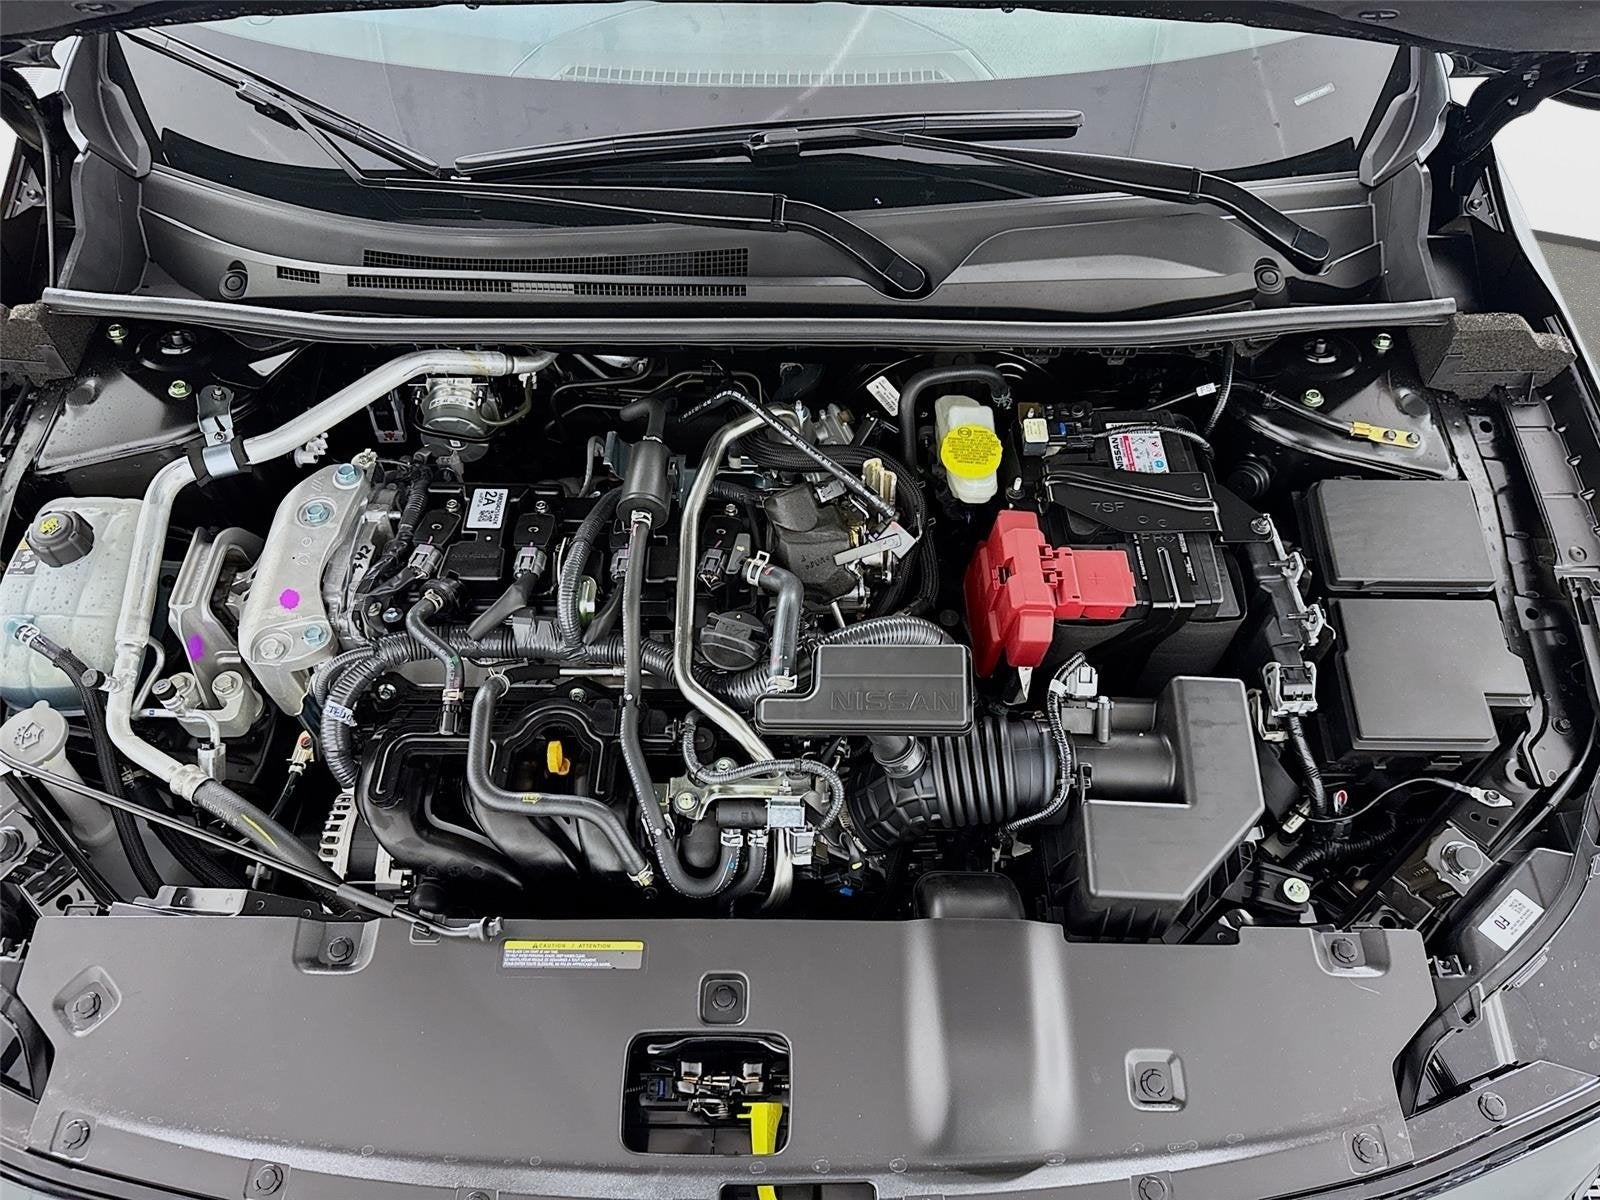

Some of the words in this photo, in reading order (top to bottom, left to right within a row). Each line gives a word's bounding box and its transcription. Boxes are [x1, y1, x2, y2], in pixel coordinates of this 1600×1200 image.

[1111, 437, 1125, 470] NISSAN
[482, 491, 498, 506] 2A
[1091, 502, 1125, 512] 7SF
[830, 691, 958, 712] NISSAN
